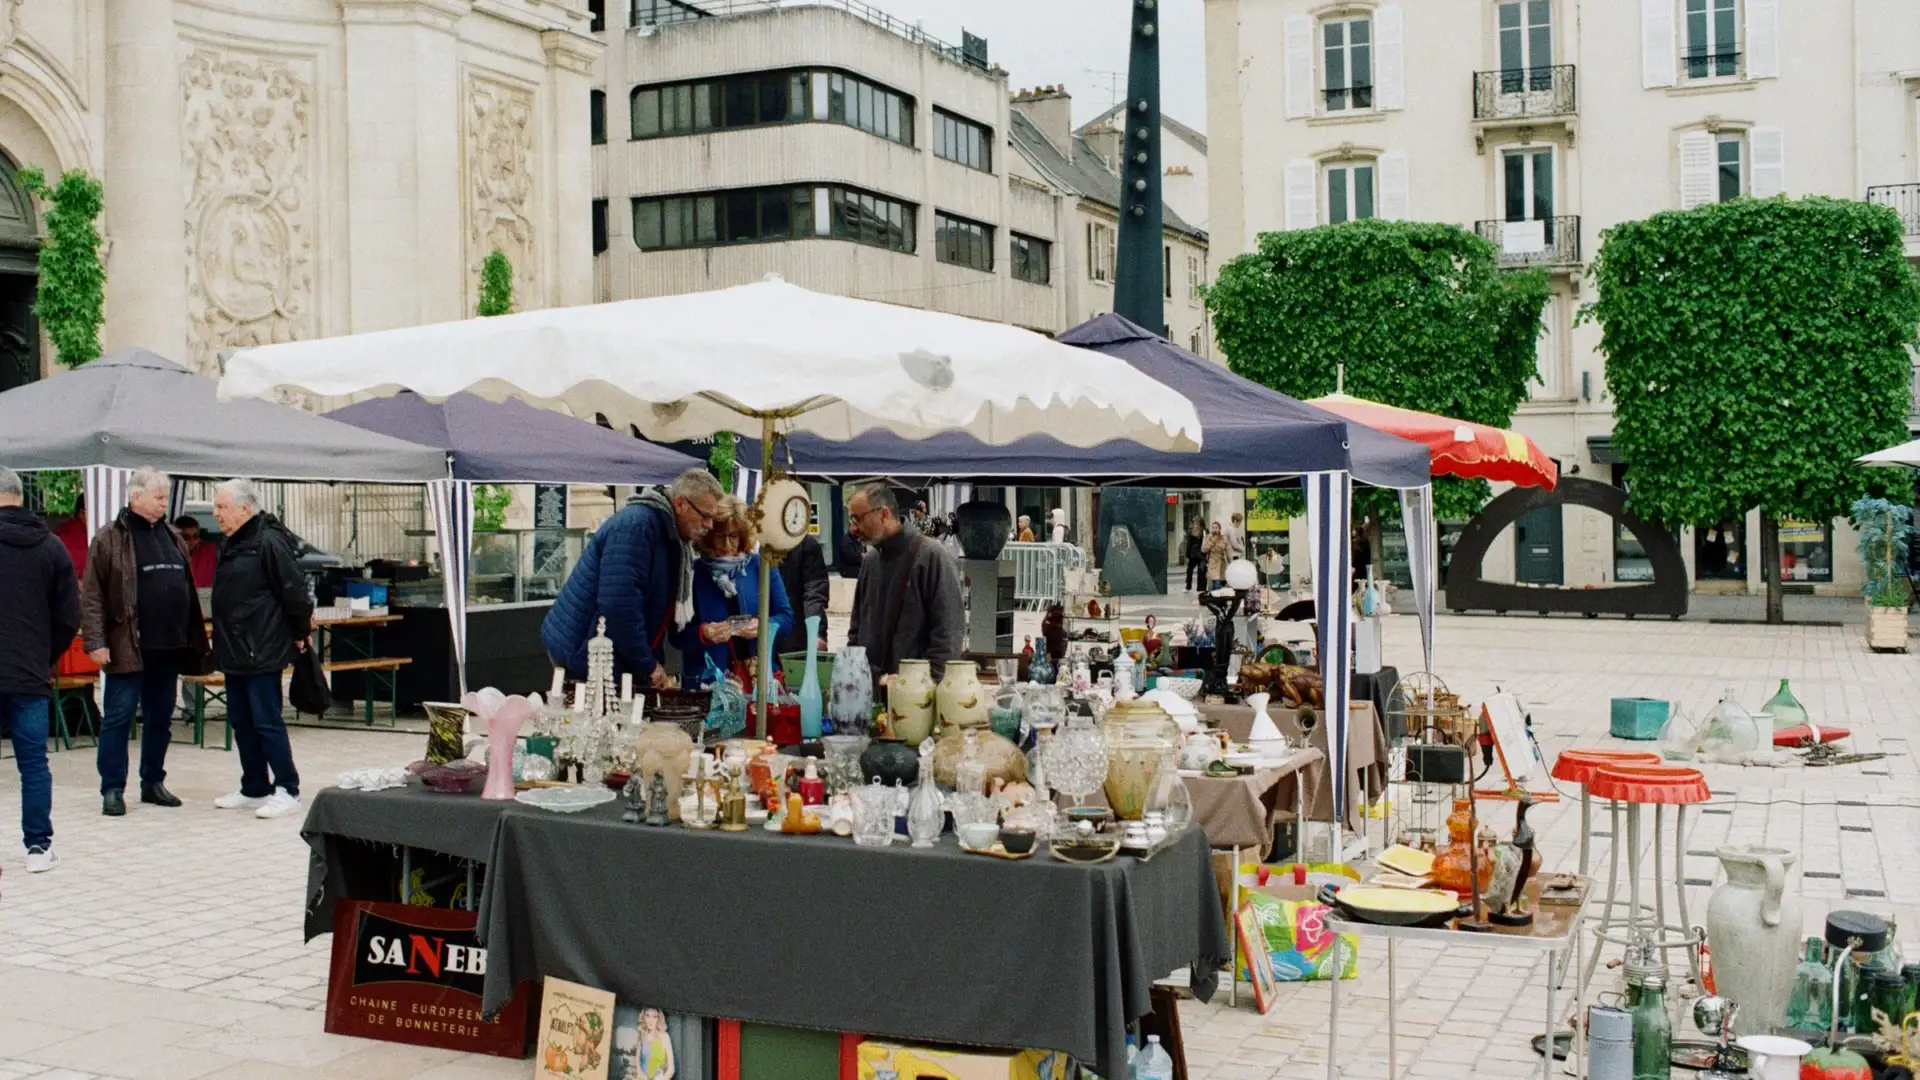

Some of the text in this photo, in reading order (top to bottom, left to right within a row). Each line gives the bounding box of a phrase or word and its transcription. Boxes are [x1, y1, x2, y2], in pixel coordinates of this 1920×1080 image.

[350, 995, 501, 1025] CHAINE EUROPÉENE
[368, 1013, 481, 1037] DE BONNETERIE
